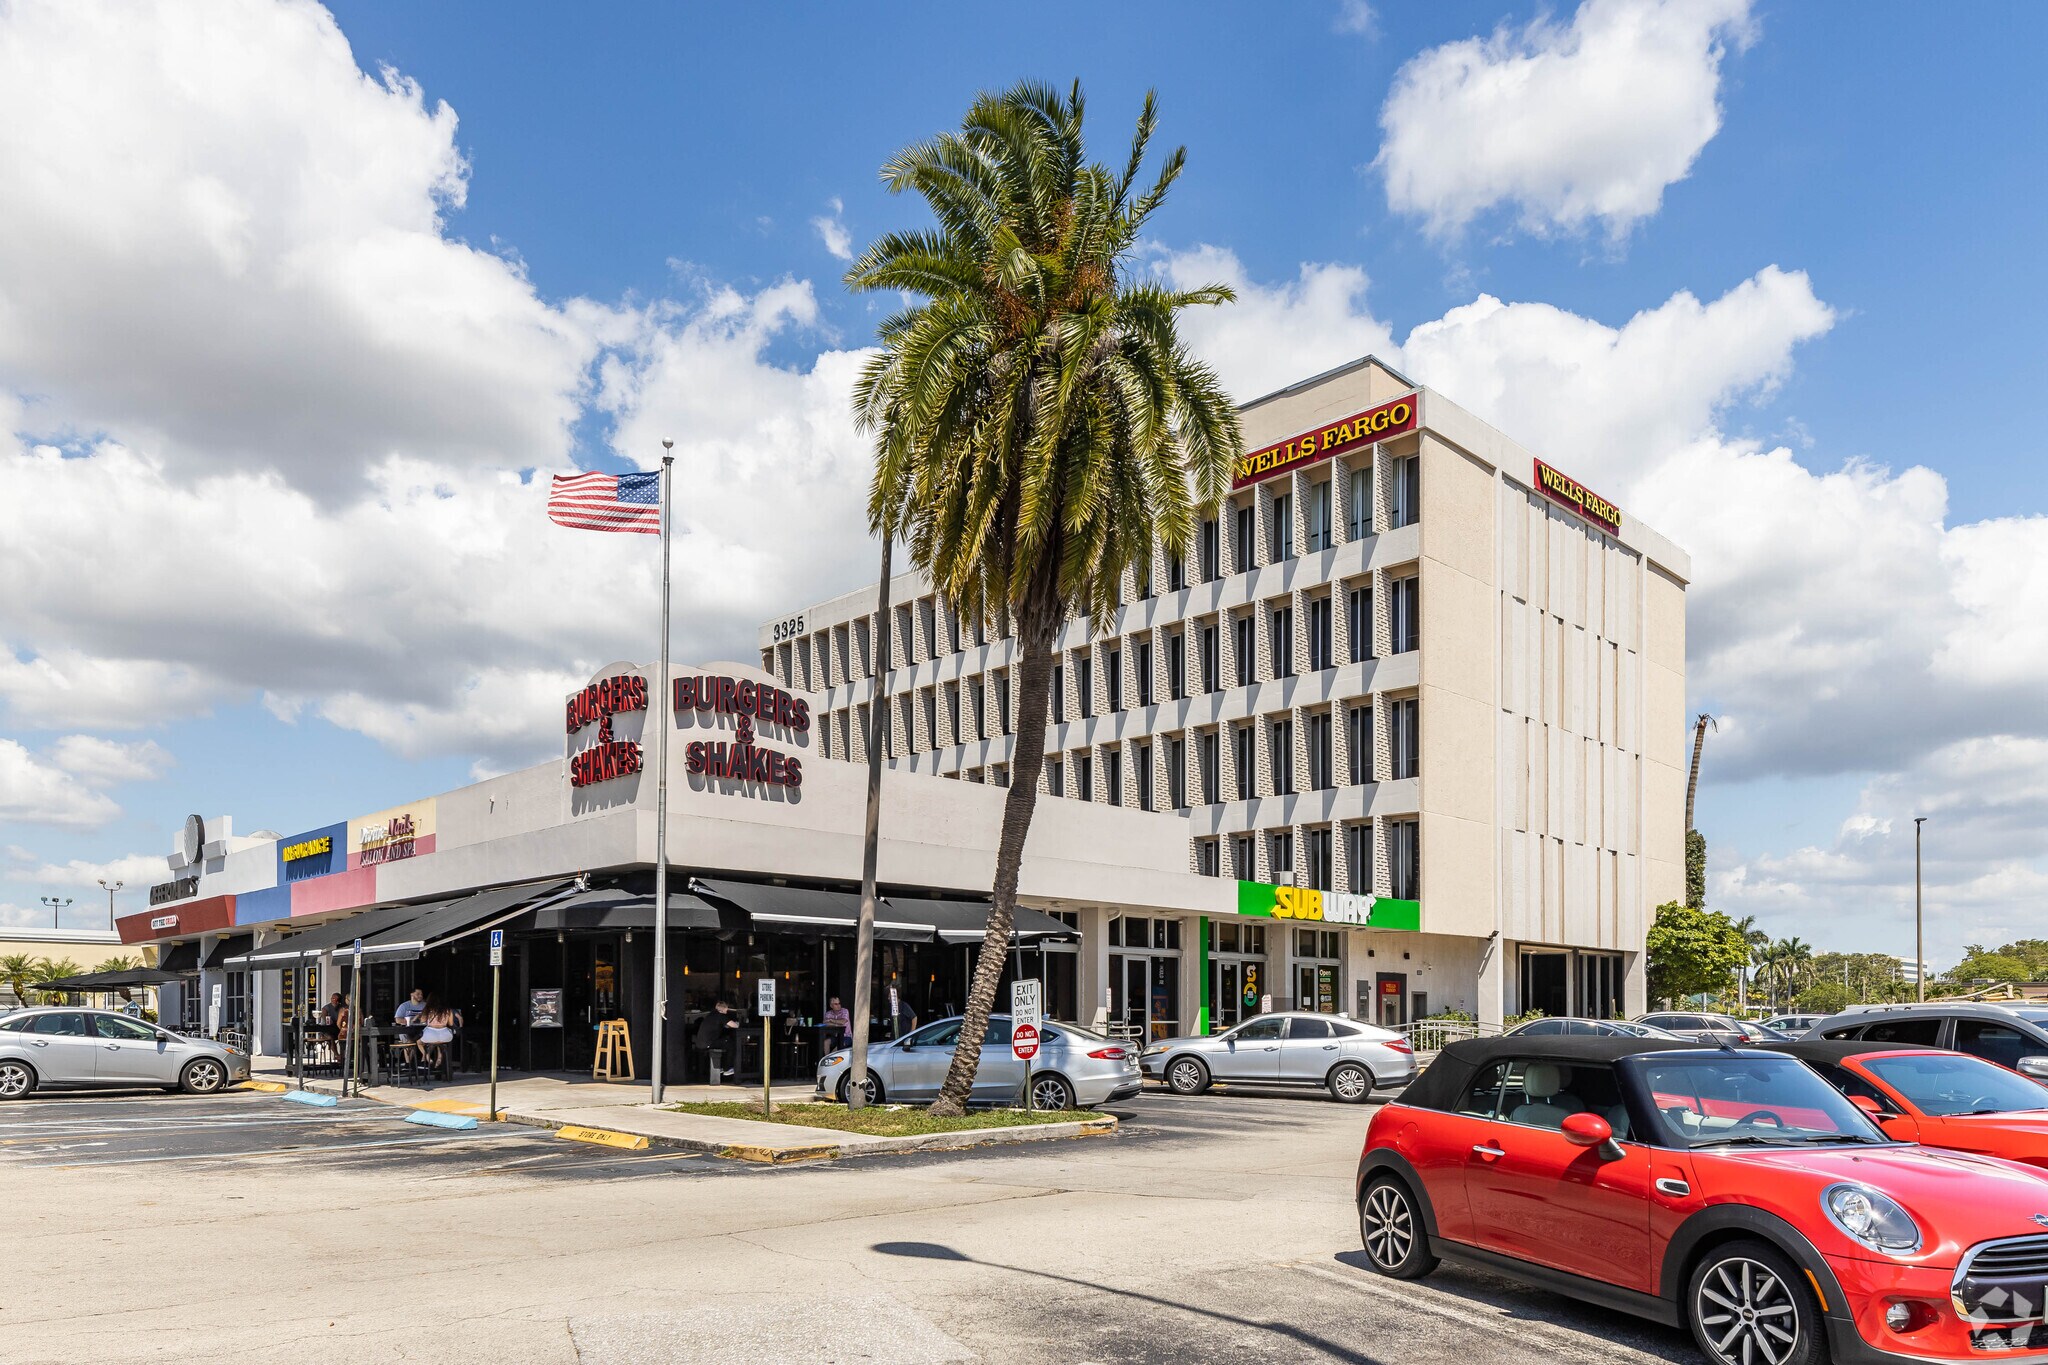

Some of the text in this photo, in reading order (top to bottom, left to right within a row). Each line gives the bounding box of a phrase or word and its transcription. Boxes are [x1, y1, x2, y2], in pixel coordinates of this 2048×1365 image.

[1234, 403, 1411, 479] WELLS FARGO
[1540, 464, 1622, 527] WELLS FARGO
[773, 616, 804, 641] 3325
[566, 676, 648, 734] BURGERS
[673, 675, 810, 732] BURGERS
[599, 716, 614, 743] &
[735, 715, 754, 744] &
[571, 742, 643, 788] SHAKES
[686, 741, 802, 787] SHAKES
[282, 836, 333, 862] INSURANCE
[361, 840, 416, 866] SALON AND SPA
[1271, 886, 1377, 925] SUBWAY
[759, 993, 774, 1002] PARKING
[761, 983, 772, 992] STORE
[1014, 994, 1036, 1007] ONLY
[1016, 983, 1034, 996] EXIT
[762, 1003, 771, 1012] ONLY
[1015, 1008, 1035, 1017] DO NOT
[1016, 1016, 1034, 1024] ENTER
[1018, 1046, 1034, 1054] ENTER
[578, 1131, 612, 1141] STORE ONLY
